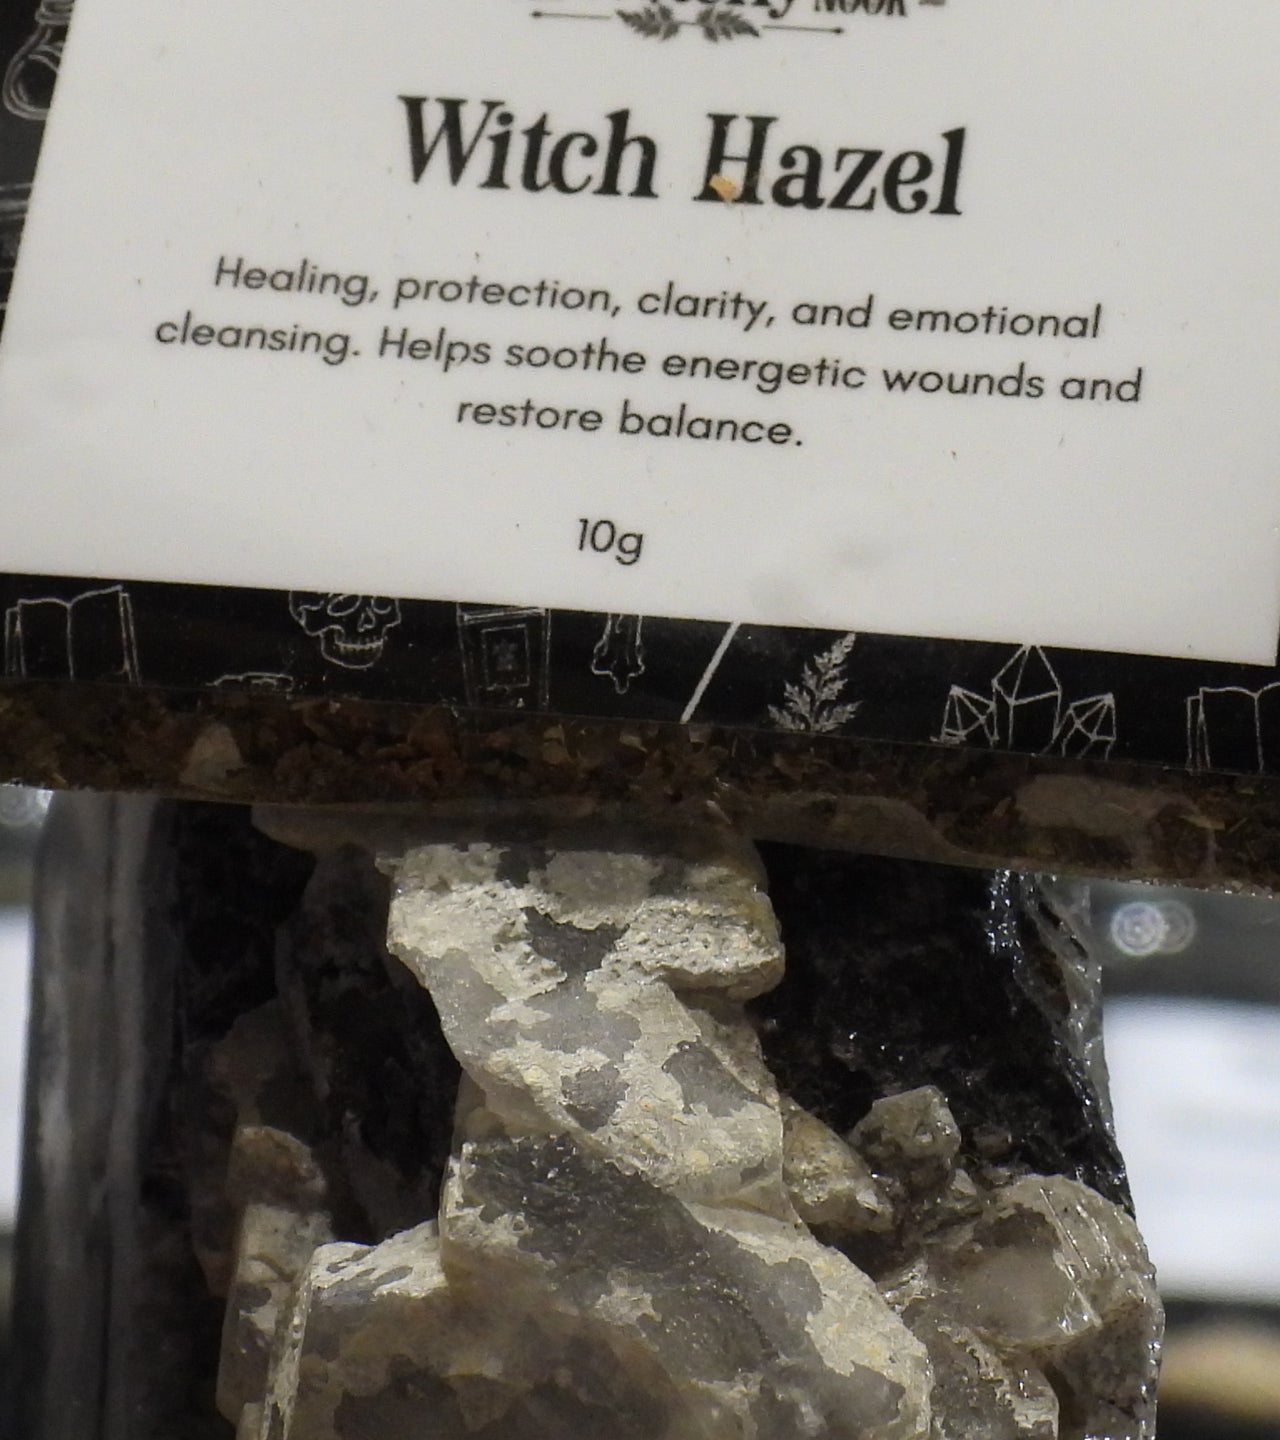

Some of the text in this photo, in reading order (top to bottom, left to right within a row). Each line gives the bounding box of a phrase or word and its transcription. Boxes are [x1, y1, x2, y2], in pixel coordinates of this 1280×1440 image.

[396, 94, 967, 217] Witch Hazel
[213, 254, 1103, 339] Healing, protection, clarity, and emotional
[154, 309, 1144, 403] cleansing. Helps soothe energetic wounds and
[456, 398, 804, 447] restore balance.
[578, 517, 644, 567] 10g
